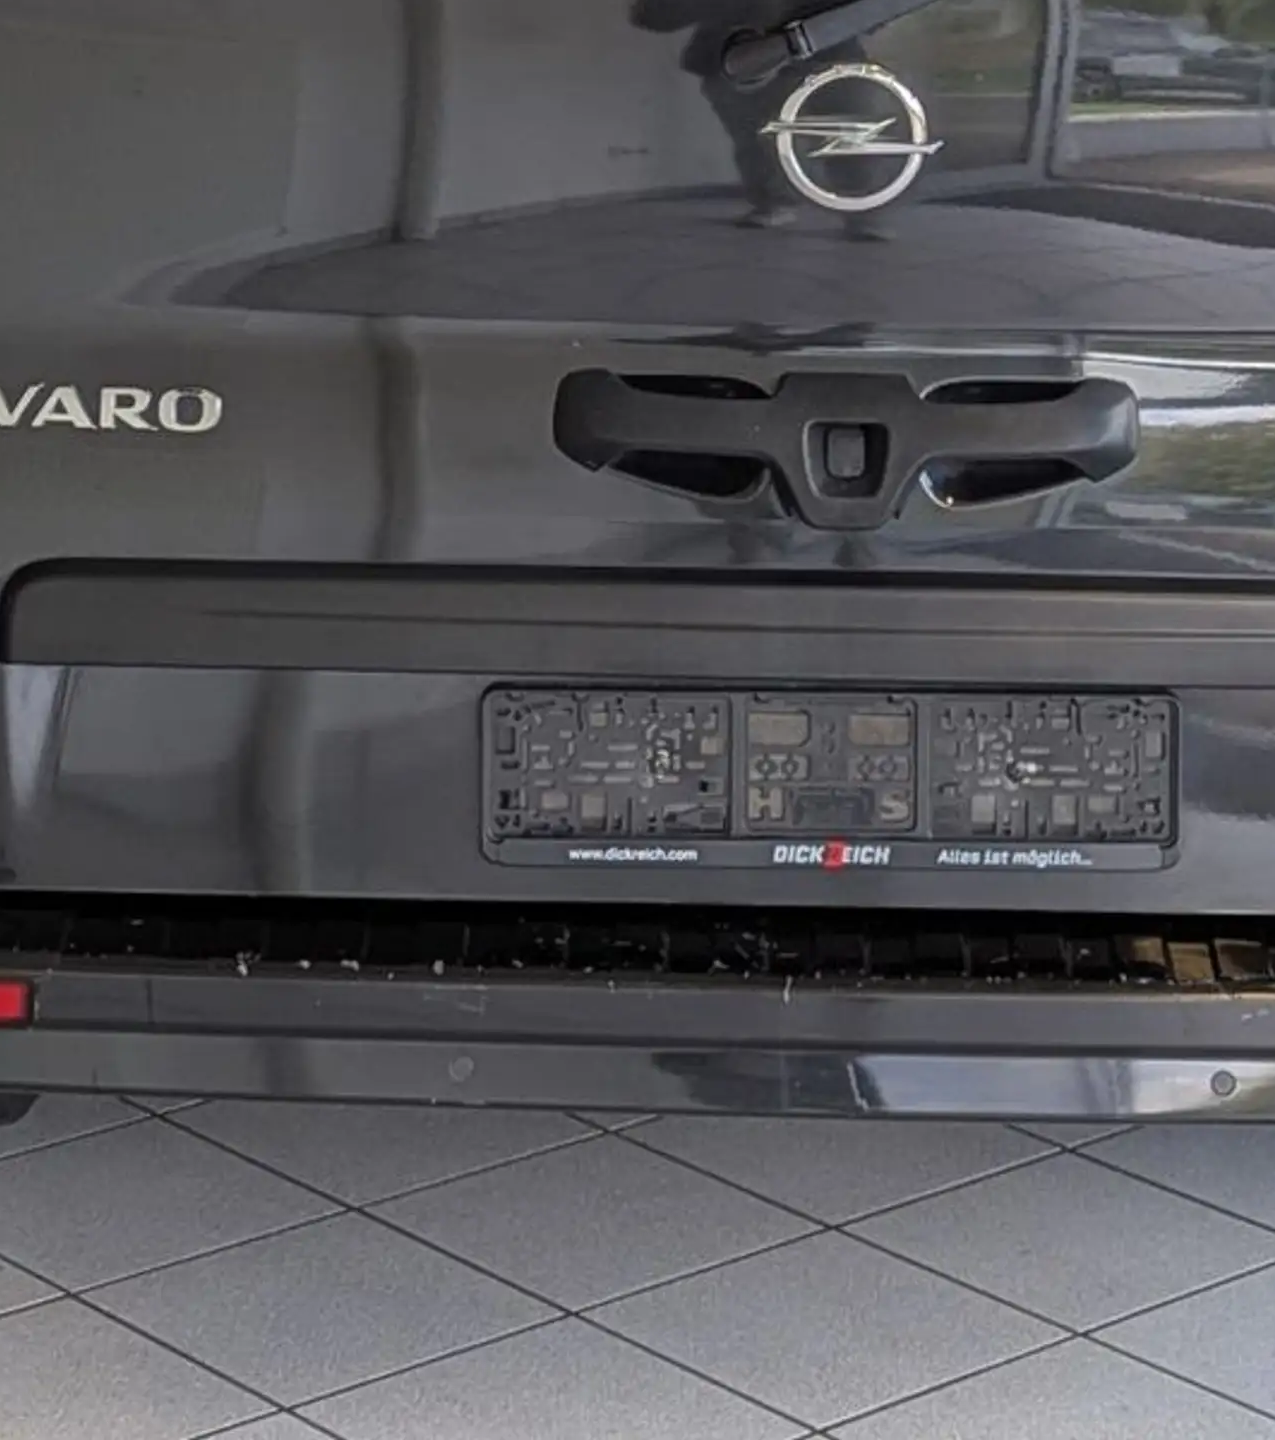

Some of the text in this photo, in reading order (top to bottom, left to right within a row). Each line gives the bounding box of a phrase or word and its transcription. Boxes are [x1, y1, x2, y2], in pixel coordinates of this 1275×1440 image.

[568, 846, 699, 861] www.dickreich.com
[936, 847, 981, 865] Alles
[983, 848, 1011, 865] ist
